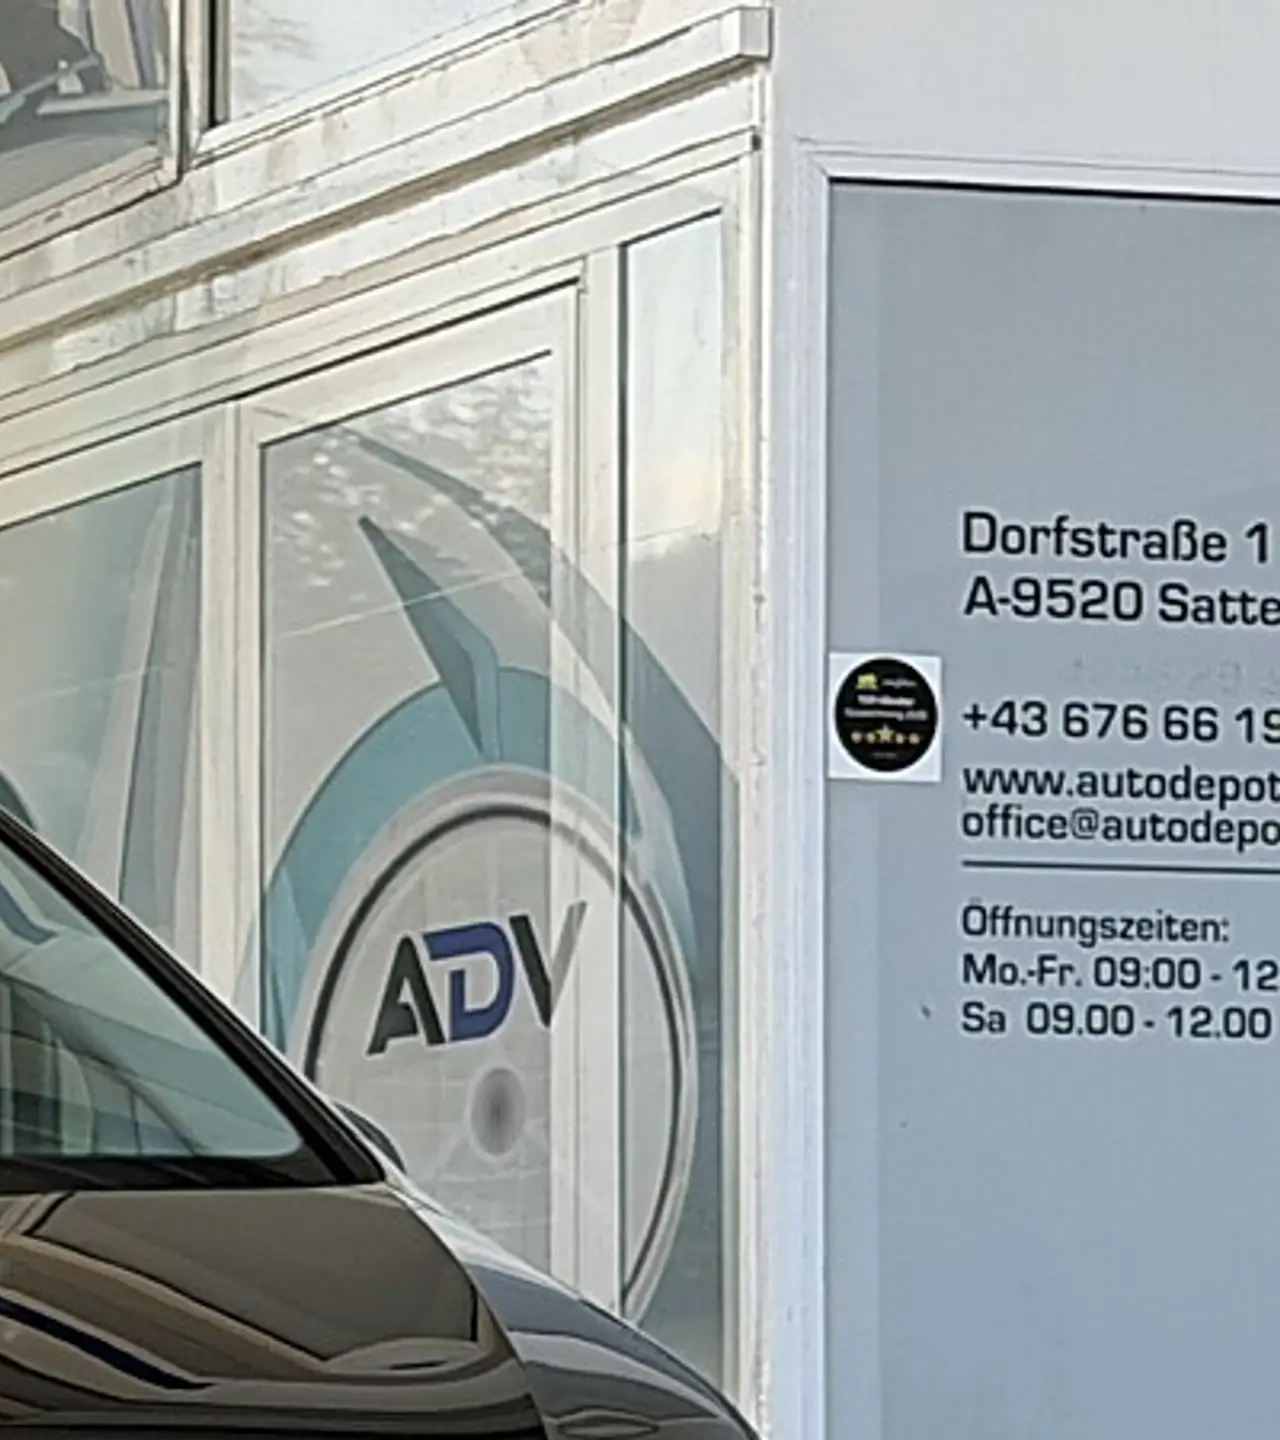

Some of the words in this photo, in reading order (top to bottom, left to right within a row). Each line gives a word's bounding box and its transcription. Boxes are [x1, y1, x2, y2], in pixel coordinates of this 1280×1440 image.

[963, 511, 1228, 562] Dorfstraße
[1244, 521, 1268, 565] 1
[963, 575, 1143, 622] A-9520
[1158, 582, 1280, 626] Satte
[961, 700, 1048, 738] +43
[1063, 702, 1148, 740] 676
[1163, 704, 1219, 742] 66
[962, 764, 1280, 811] www.autodepot
[962, 803, 1280, 853] office@autodepo
[962, 896, 1230, 948] Öffnungszeiten:
[366, 900, 587, 1056] ADV
[962, 953, 1083, 987] Mo.-Fr.
[1094, 955, 1202, 990] 09:00
[1233, 959, 1280, 993] 12
[962, 1001, 1007, 1034] Sa
[1026, 1002, 1135, 1036] 09.00
[1166, 1005, 1273, 1040] 12.00
